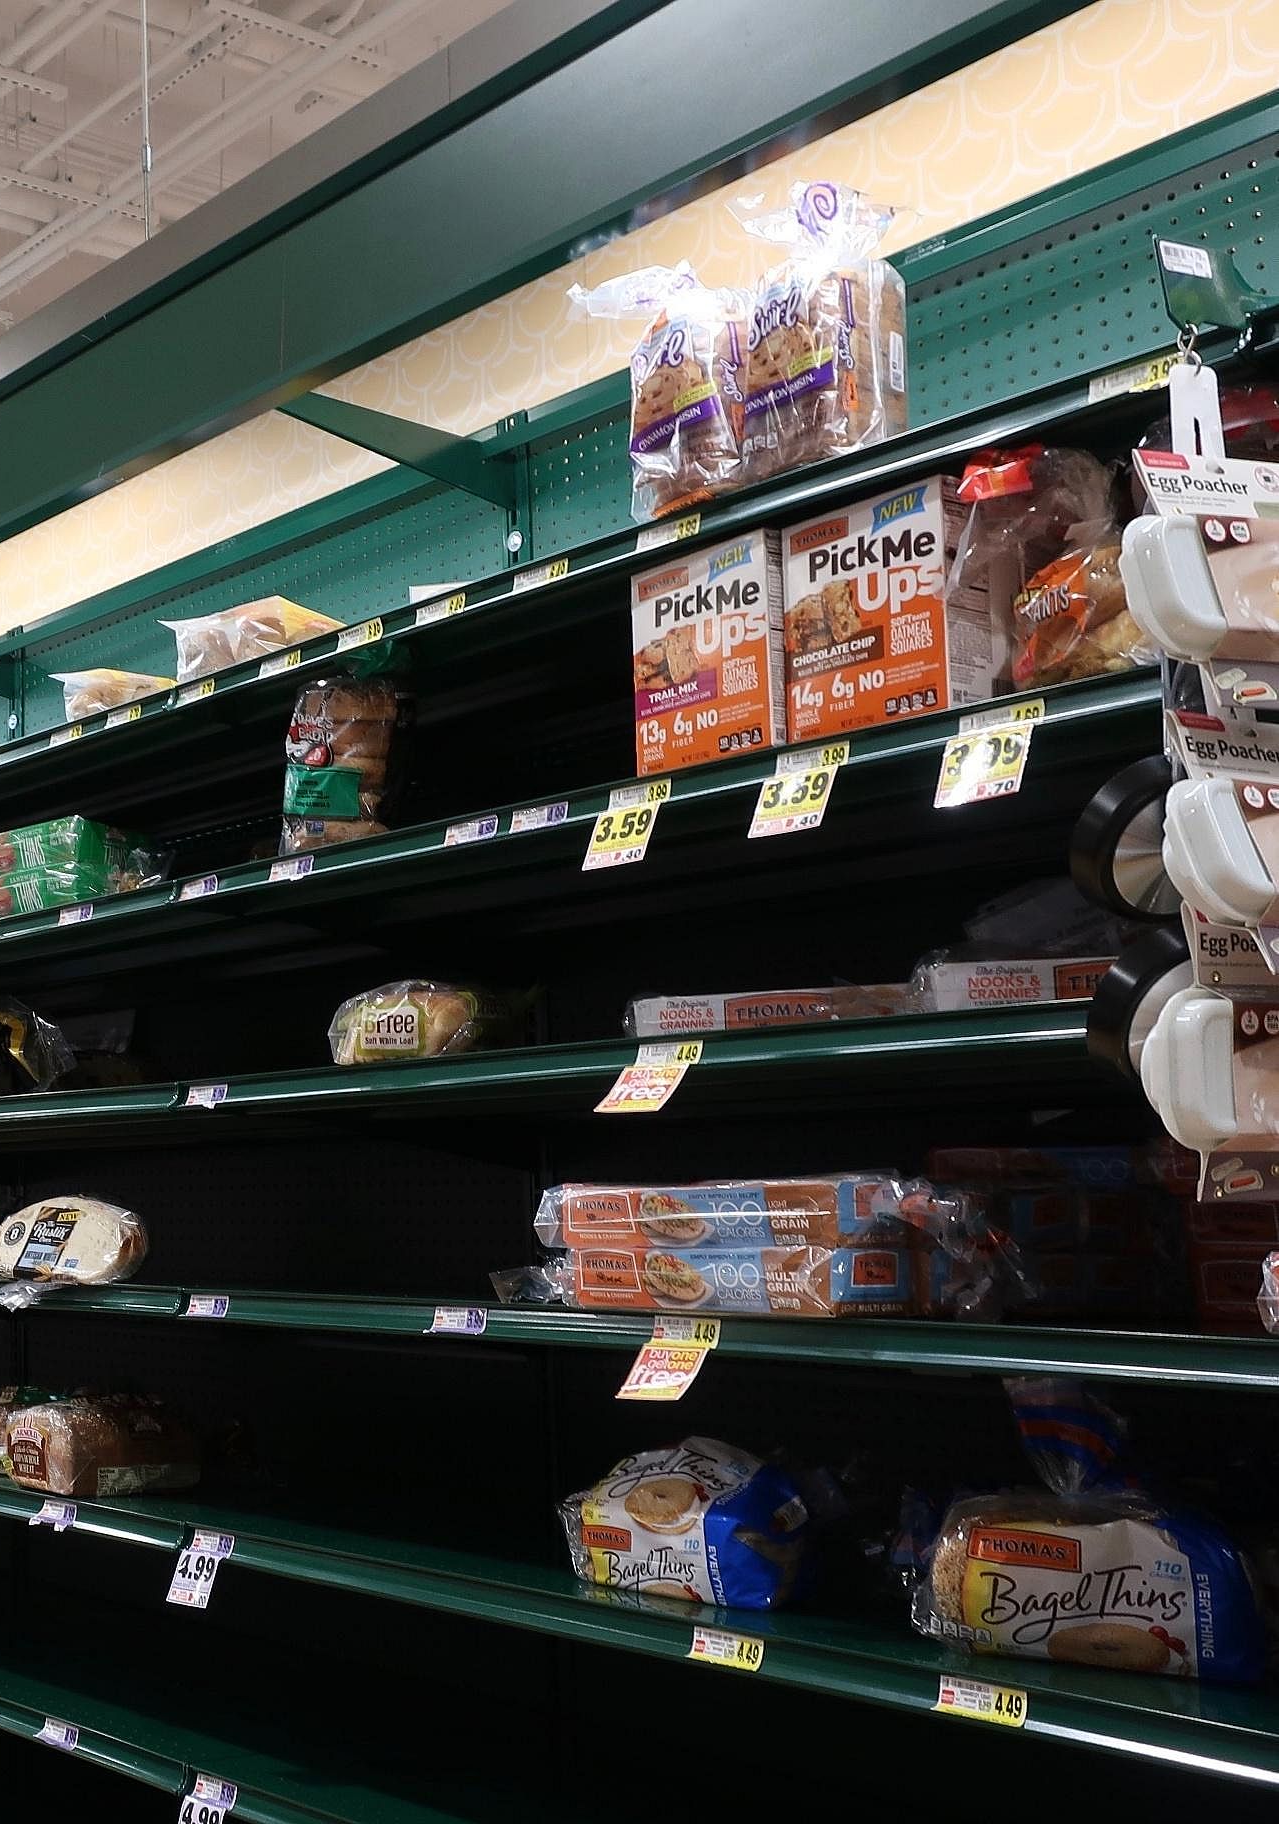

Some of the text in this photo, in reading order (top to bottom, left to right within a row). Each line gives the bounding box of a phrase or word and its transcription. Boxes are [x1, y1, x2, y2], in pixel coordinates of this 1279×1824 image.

[748, 287, 802, 351] Swirl
[1146, 471, 1249, 497] Egg Poacher
[879, 490, 919, 523] NEW
[713, 543, 747, 571] NEW
[809, 528, 936, 584] Pick Me
[856, 564, 946, 614] Ups
[654, 579, 761, 629] Pick Me
[695, 612, 768, 657] Ups
[890, 622, 933, 643] OATMEAL
[792, 642, 850, 668] CHOCOLATE
[850, 635, 876, 652] CHIP
[890, 636, 934, 656] SQUARES
[722, 664, 758, 684] OATMEAL
[648, 681, 699, 704] TRAIL MIX
[722, 679, 759, 698] SQUARES
[791, 682, 824, 710] 14g
[831, 672, 855, 699] 6g
[858, 668, 885, 693] NO
[830, 699, 856, 713] FIBER
[639, 719, 667, 746] 13g
[673, 711, 693, 736] 6g
[696, 709, 718, 730] NO
[672, 736, 694, 749] FIBER
[1185, 735, 1218, 760] Egg
[763, 772, 830, 809] 3.59
[595, 808, 653, 843] 3.59
[1200, 932, 1228, 958] Egg
[968, 975, 1042, 989] NOOKS &
[968, 987, 1042, 1001] CRANNIES
[659, 1006, 714, 1021] NOOKS &
[735, 1003, 818, 1022] THOMAS
[659, 1018, 715, 1031] CRANNIES
[610, 1083, 667, 1101] free
[709, 1201, 764, 1227] 100
[771, 1217, 810, 1230] GRAIN
[33, 1221, 71, 1240] Rustik
[715, 1226, 766, 1239] CALORIES
[710, 1263, 760, 1288] 100
[715, 1287, 762, 1301] CALORIES
[694, 1323, 716, 1343] 4.49
[631, 1364, 690, 1387] free
[587, 1531, 626, 1544] THOMAS
[684, 1539, 700, 1550] 110
[981, 1538, 1067, 1560] THOMAS
[178, 1554, 216, 1582] 4.99
[602, 1546, 695, 1592] Bagel Thins
[1154, 1560, 1182, 1575] 110
[980, 1565, 1185, 1645] Bagel Thins
[1196, 1573, 1215, 1659] EVERYTHING
[738, 1641, 760, 1664] 4.49
[995, 1692, 1023, 1718] 4.49
